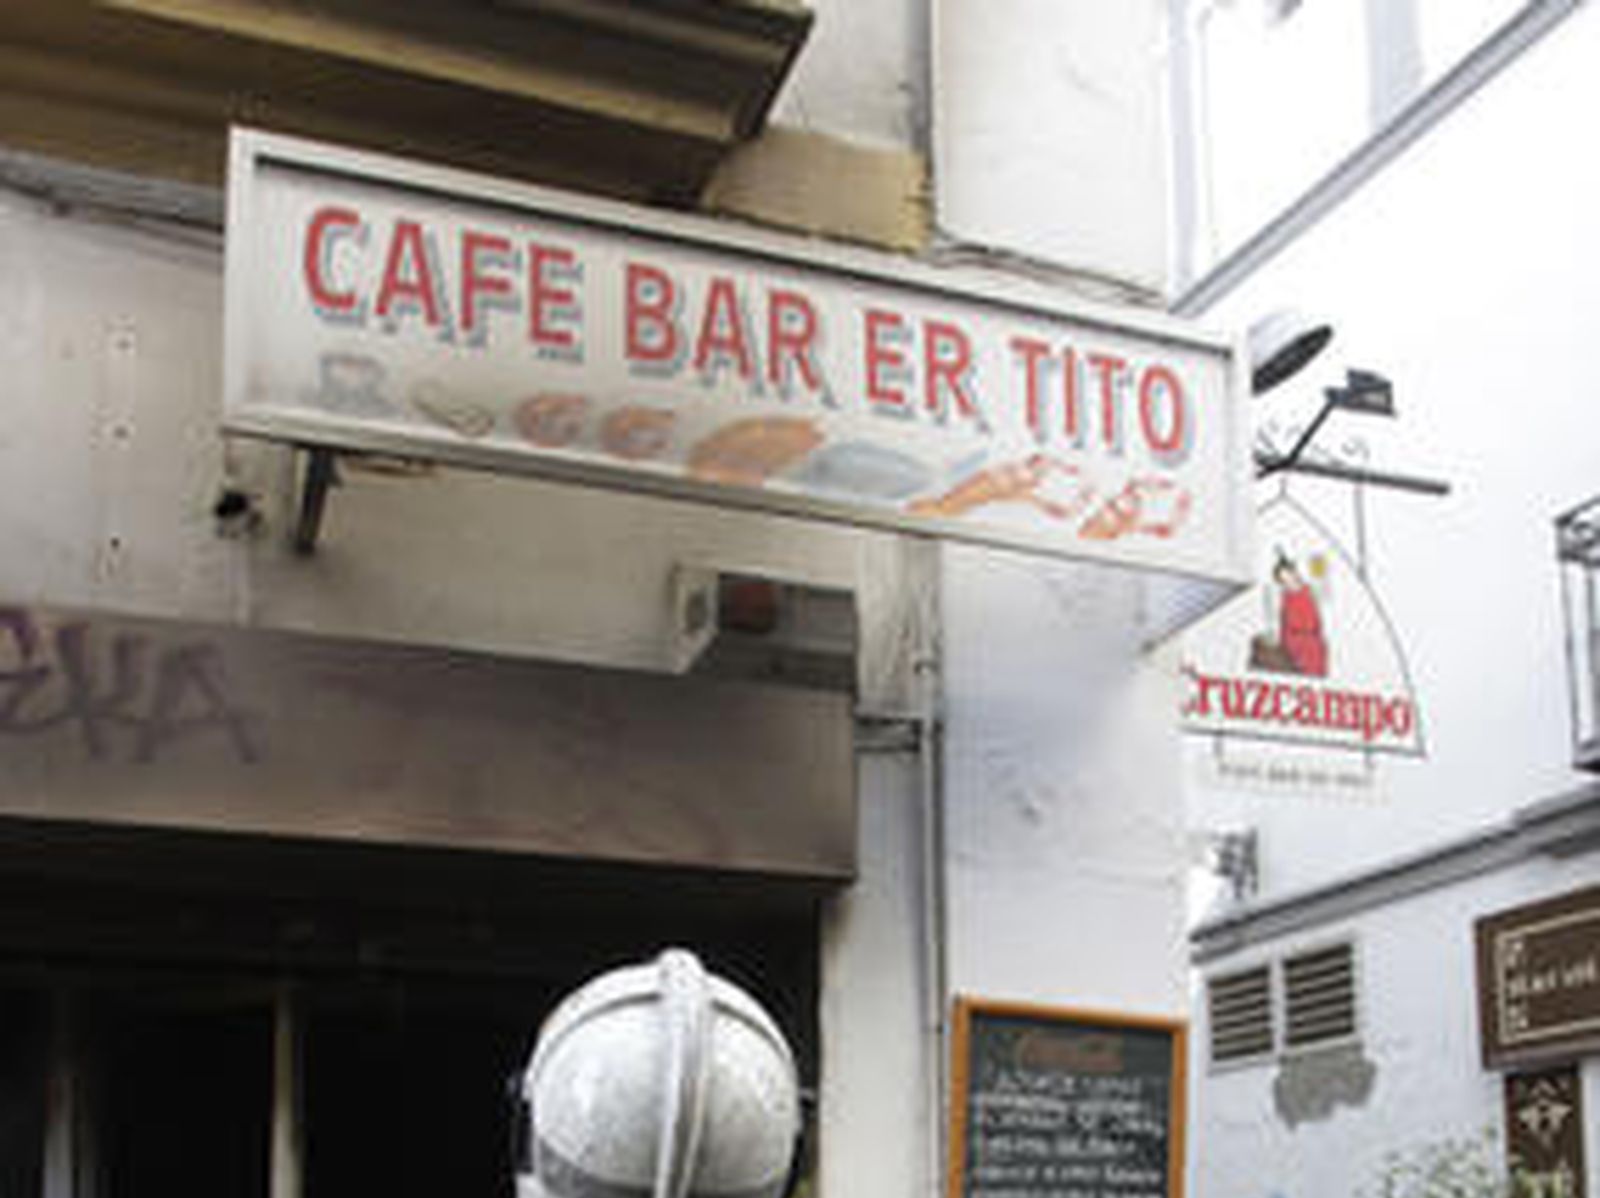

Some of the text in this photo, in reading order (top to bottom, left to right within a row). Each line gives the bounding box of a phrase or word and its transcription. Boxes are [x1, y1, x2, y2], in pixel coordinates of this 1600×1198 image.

[304, 207, 1188, 455] CAFE BAR ER TITO
